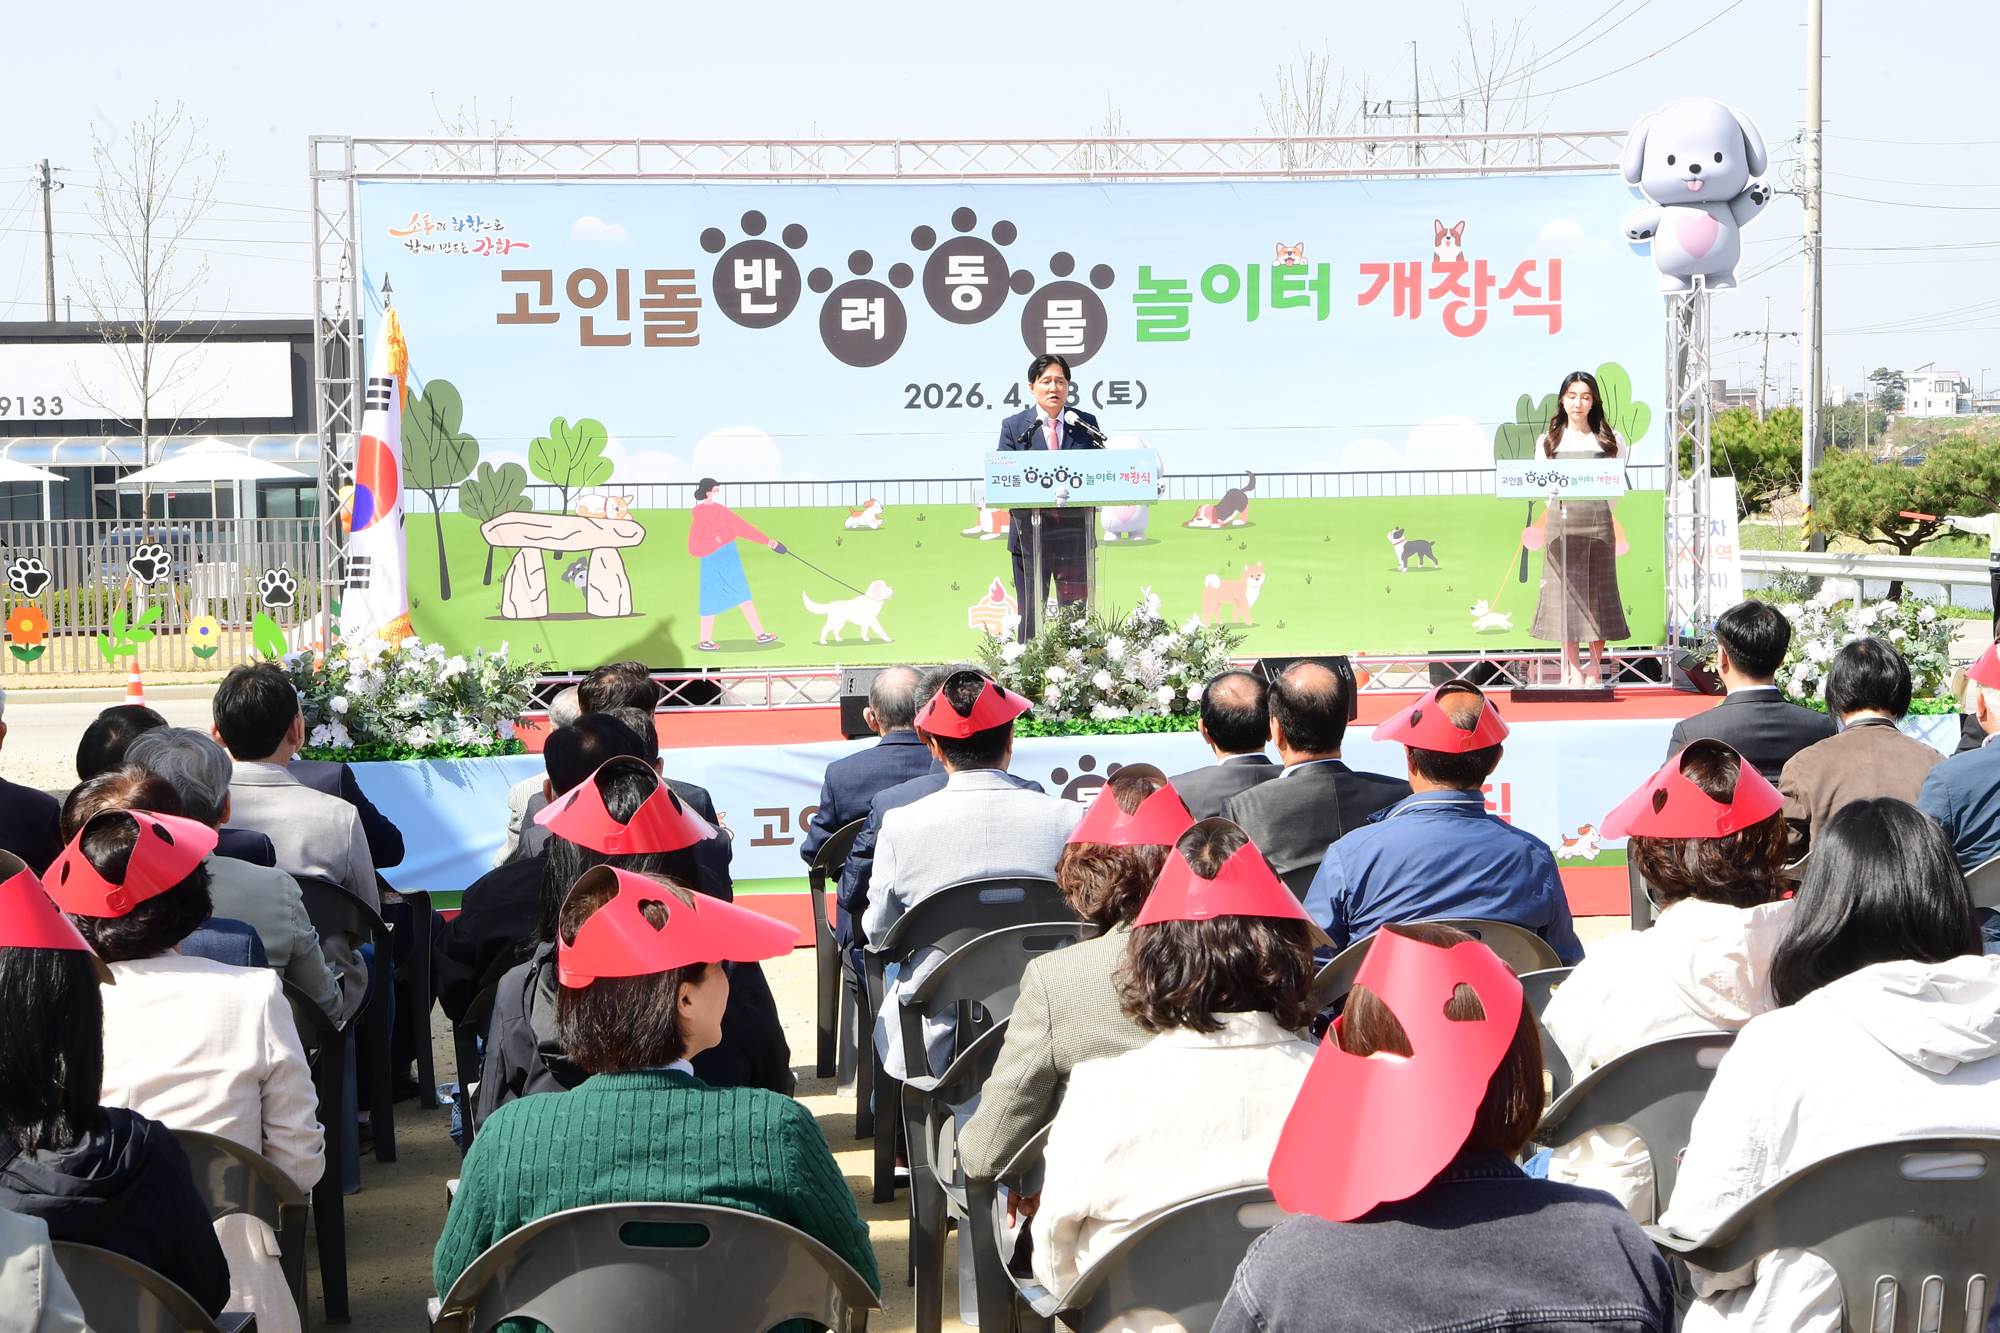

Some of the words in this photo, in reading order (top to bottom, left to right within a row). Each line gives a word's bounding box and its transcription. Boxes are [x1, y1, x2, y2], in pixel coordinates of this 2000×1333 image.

[388, 213, 448, 237] 소통과
[404, 239, 436, 255] 함께
[439, 241, 469, 255] 만드는
[472, 236, 530, 257] 강화
[496, 267, 702, 347] 고인돌
[733, 255, 1088, 354] 반려동물
[1132, 262, 1331, 343] 놀이터
[1357, 258, 1563, 338] 개장식
[903, 382, 993, 410] 2026.
[1091, 379, 1148, 410] (토)
[0, 396, 64, 417] 9133
[991, 475, 1022, 488] 고인돌
[1085, 473, 1116, 486] 놀이터
[1119, 472, 1151, 485] 개장식
